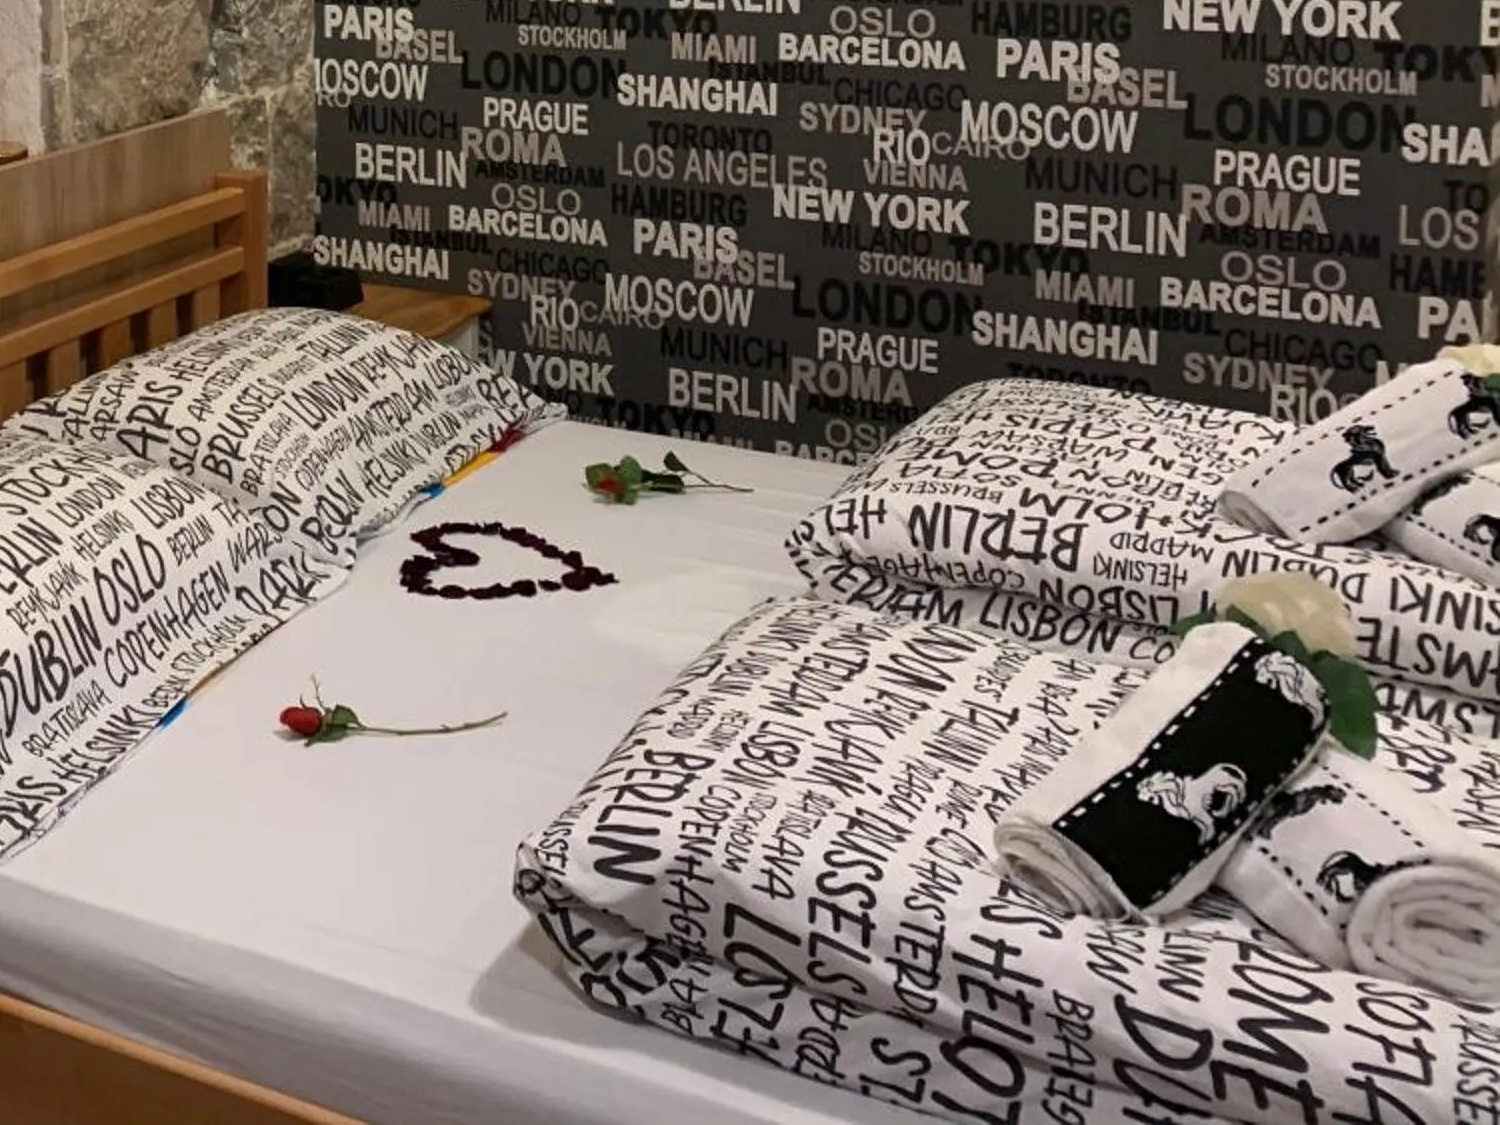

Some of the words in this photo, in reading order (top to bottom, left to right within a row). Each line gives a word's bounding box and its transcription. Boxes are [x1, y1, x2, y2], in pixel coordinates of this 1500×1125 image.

[518, 24, 627, 50] STOCKHOLM
[671, 32, 756, 63] MIAMI
[778, 32, 965, 71] BARCELONA
[997, 39, 1121, 83] PARIS
[617, 73, 777, 116] SHANGHAI
[1066, 67, 1188, 110] BASEL
[1266, 64, 1418, 96] STOCKHOLM
[483, 97, 589, 136] PRAGUE
[960, 98, 1138, 154] MOSCOW
[356, 142, 466, 189] BERLIN
[461, 126, 567, 167] ROMA
[617, 141, 683, 178] LOS
[685, 144, 828, 189] ANGELES
[1214, 149, 1360, 196] PRAGUE
[492, 183, 581, 216] OSLO
[773, 186, 852, 223] NEW
[864, 193, 970, 236] YORK
[1181, 183, 1329, 234] ROMA
[449, 205, 608, 246] BARCELONA
[634, 218, 738, 265] PARIS
[1034, 202, 1188, 257] BERLIN
[1036, 268, 1134, 309] MIAMI
[1221, 251, 1346, 292] OSLO
[605, 273, 754, 328] MOSCOW
[1160, 276, 1381, 329] BARCELONA
[817, 328, 938, 374] PRAGUE
[971, 311, 1157, 366] SHANGHAI
[282, 367, 370, 430] LONDON
[349, 379, 438, 451] AMSTERDAM
[668, 369, 797, 424] BERLIN
[202, 377, 285, 484] BRUSSELS
[357, 437, 426, 499] HELSINKI
[48, 474, 126, 527] LONDON
[130, 474, 205, 530] LISBON
[76, 510, 134, 561] HELSINKI
[909, 503, 1090, 572] BERLIN
[1110, 532, 1214, 563] MADRID
[92, 535, 167, 626] OSLO
[1093, 552, 1188, 591] HELSINKI
[103, 561, 230, 688] COPENHAGEN
[980, 591, 1120, 654] LISBON
[1040, 578, 1179, 625] LISBON
[22, 681, 110, 758] BRATISLAVA
[53, 705, 156, 790] HELSINKI
[588, 747, 713, 886] BERLIN
